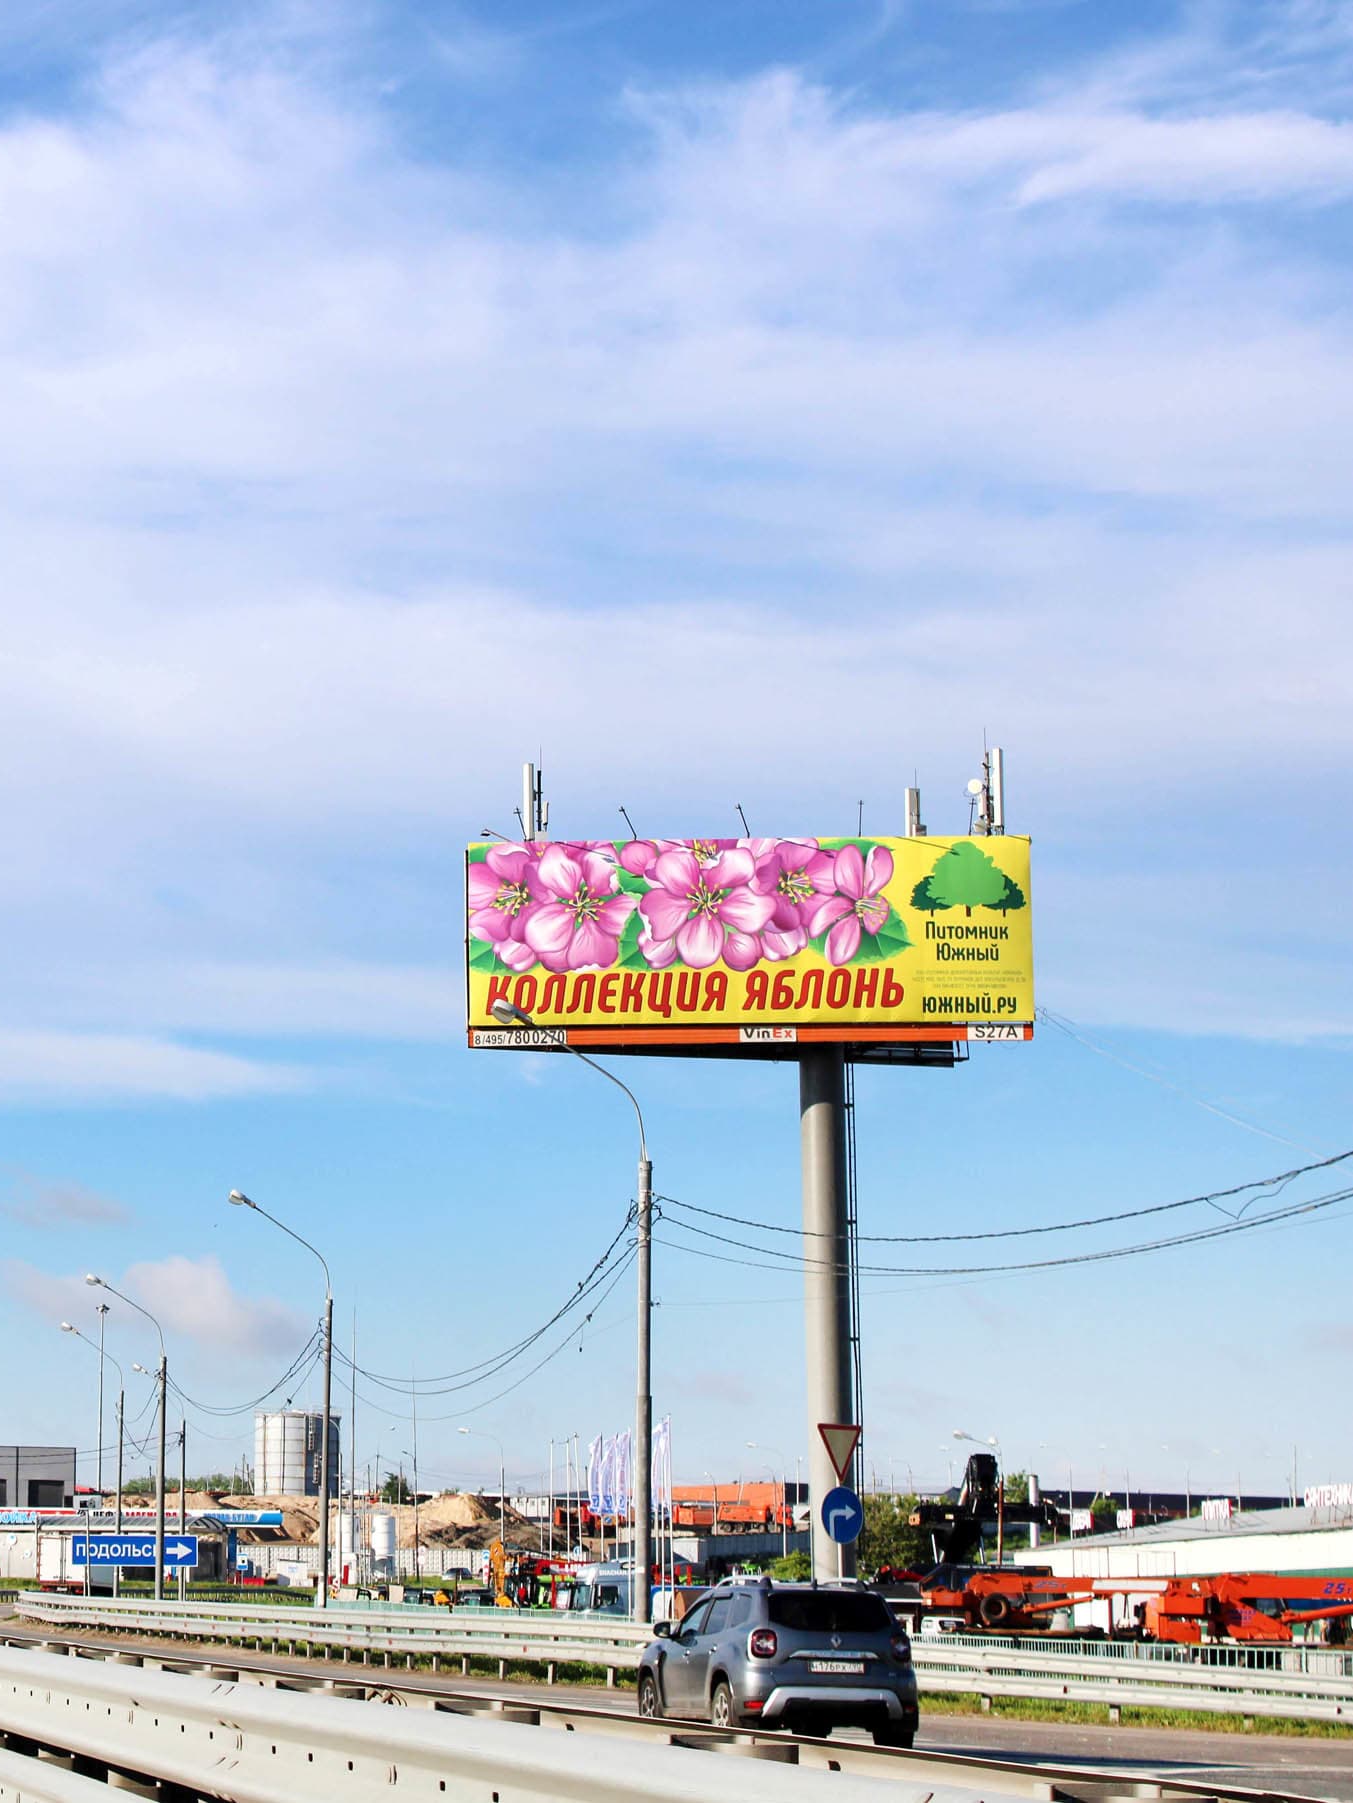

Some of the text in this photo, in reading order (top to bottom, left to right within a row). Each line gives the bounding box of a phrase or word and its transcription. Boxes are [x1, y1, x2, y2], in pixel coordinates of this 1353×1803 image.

[925, 920, 1009, 940] Питомник
[936, 942, 1000, 961] Южный
[485, 970, 728, 1018] КОЛЛЕКЦИЯ
[742, 967, 905, 1011] ЯБЛОНЬ
[922, 992, 1017, 1014] ЮЖНЫЙ.РУ
[743, 1027, 793, 1039] VinEx
[975, 1025, 1018, 1039] S27A
[75, 1543, 157, 1560] ПОДОЛЬС
